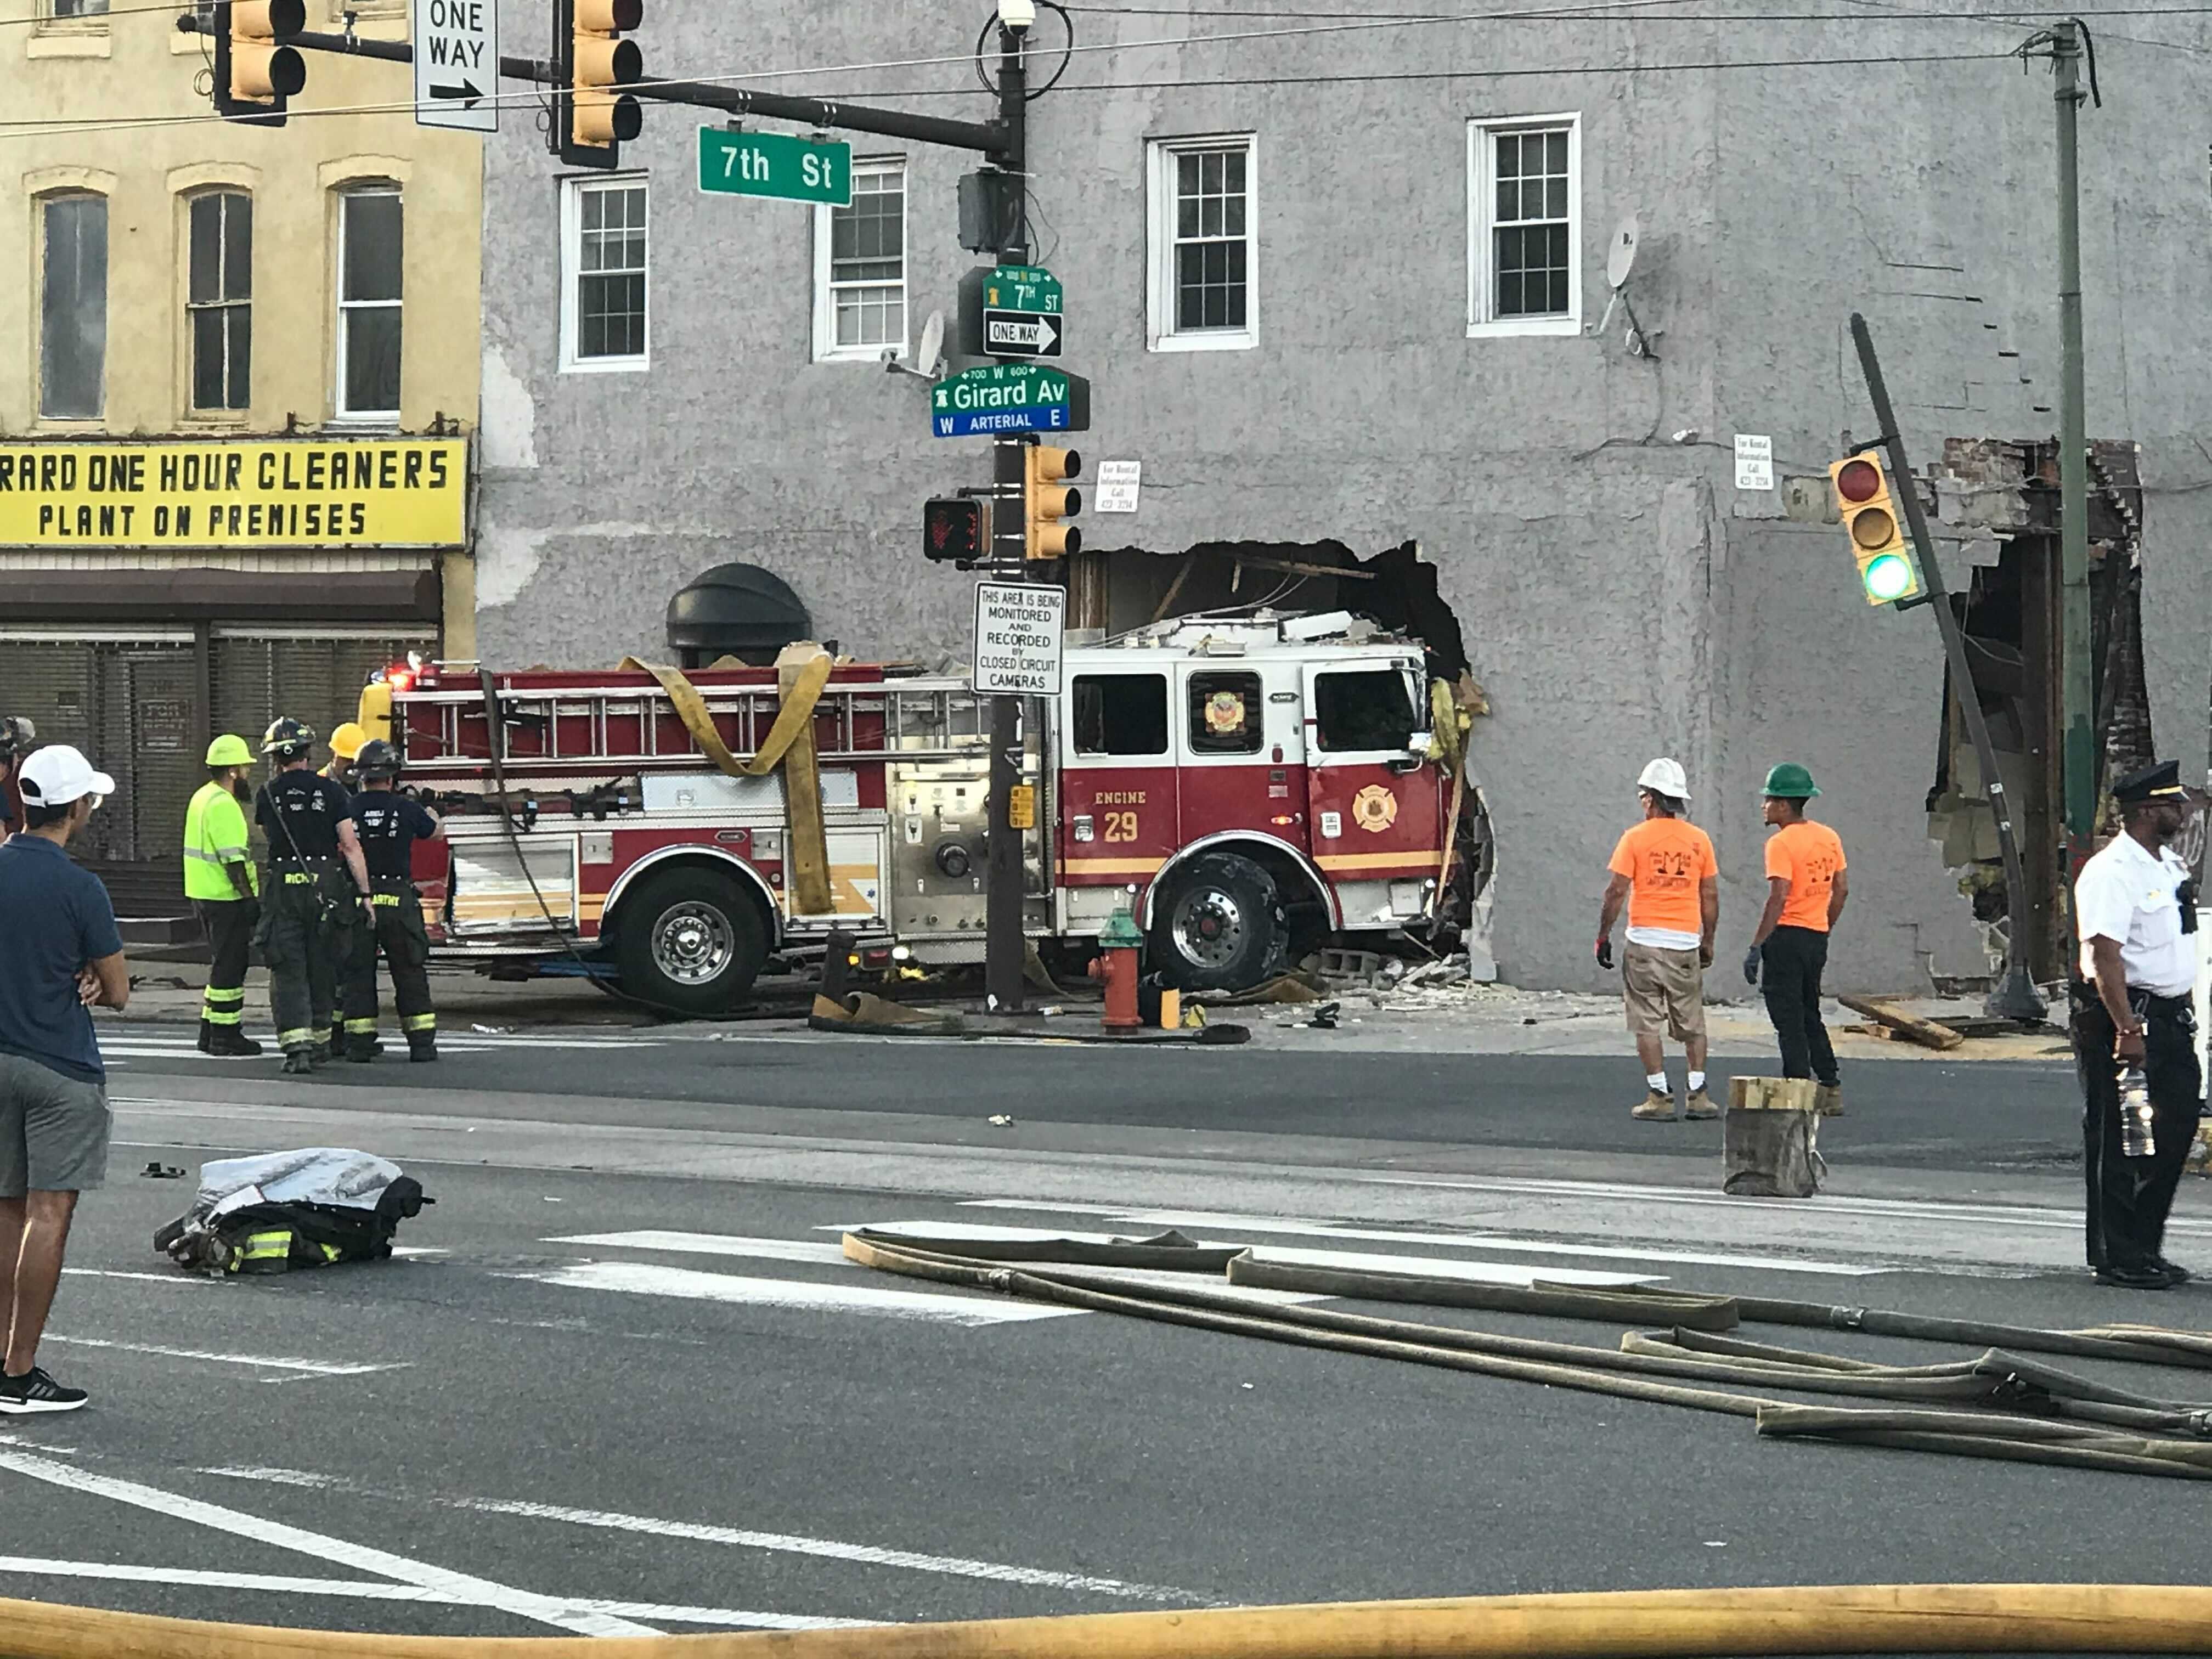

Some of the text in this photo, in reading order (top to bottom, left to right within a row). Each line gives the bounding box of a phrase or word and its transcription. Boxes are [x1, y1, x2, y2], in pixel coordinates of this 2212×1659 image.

[430, 0, 483, 32] ONE
[429, 36, 484, 69] WAY
[720, 146, 832, 188] 7th St
[1014, 284, 1058, 311] 7TH ST
[993, 324, 1039, 342] ONE WAY
[970, 369, 986, 379] 700
[994, 366, 1003, 380] W
[954, 380, 1065, 409] Girard Av
[940, 409, 1060, 433] W ARTERIAL E
[0, 450, 447, 492] RARD ONE HOUR CLEANERS
[40, 502, 365, 537] PLANT ON PREMISES
[982, 590, 1060, 608] THIS AREA IS BEING
[989, 607, 1051, 622] MONITORED
[1008, 623, 1032, 632] AND
[988, 632, 1051, 648] RECORDED
[1012, 648, 1024, 656] BY
[980, 656, 1056, 672] CLOSED CIRCUIT
[990, 673, 1045, 689] CAMERAS
[1095, 791, 1146, 805] ENGINE
[1104, 811, 1138, 842] 29
